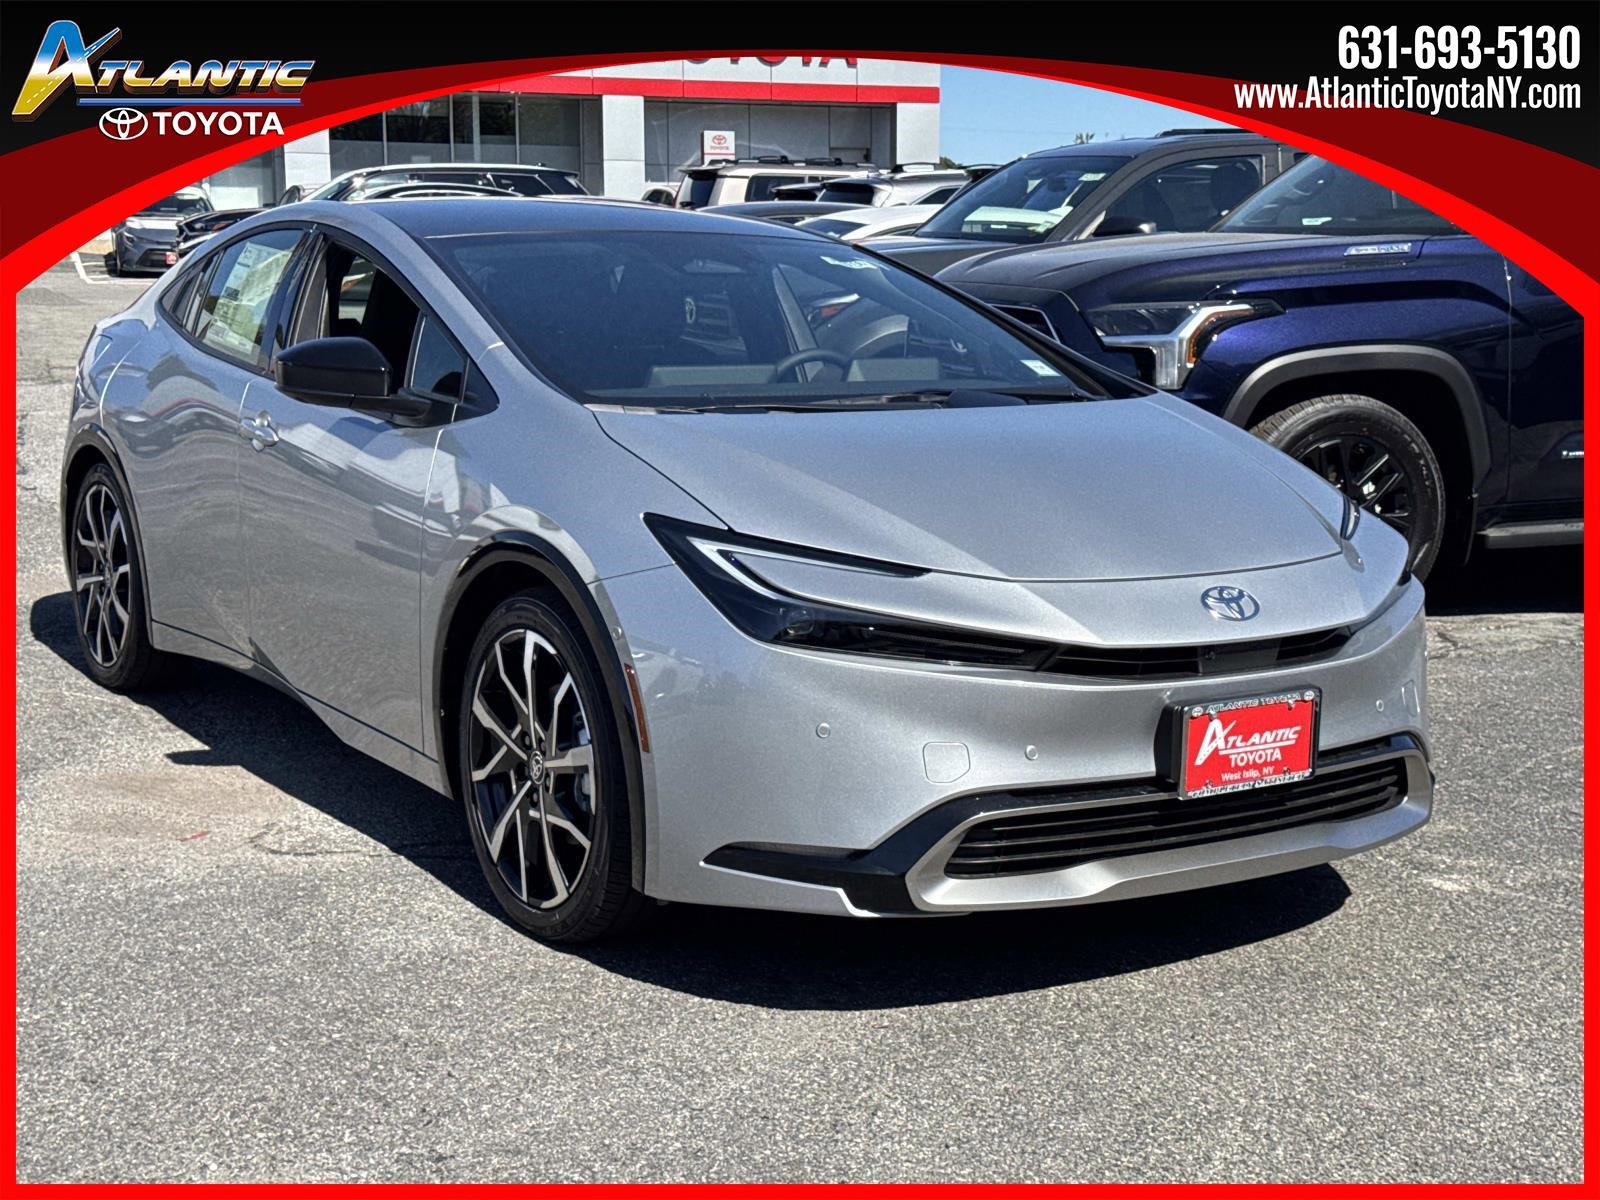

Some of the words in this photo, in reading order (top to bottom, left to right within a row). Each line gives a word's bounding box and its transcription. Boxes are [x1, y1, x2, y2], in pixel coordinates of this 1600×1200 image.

[1194, 718, 1302, 766] ATLANTIC
[1229, 748, 1282, 768] TOYOTA
[1221, 770, 1242, 782] West
[1262, 765, 1275, 776] NY
